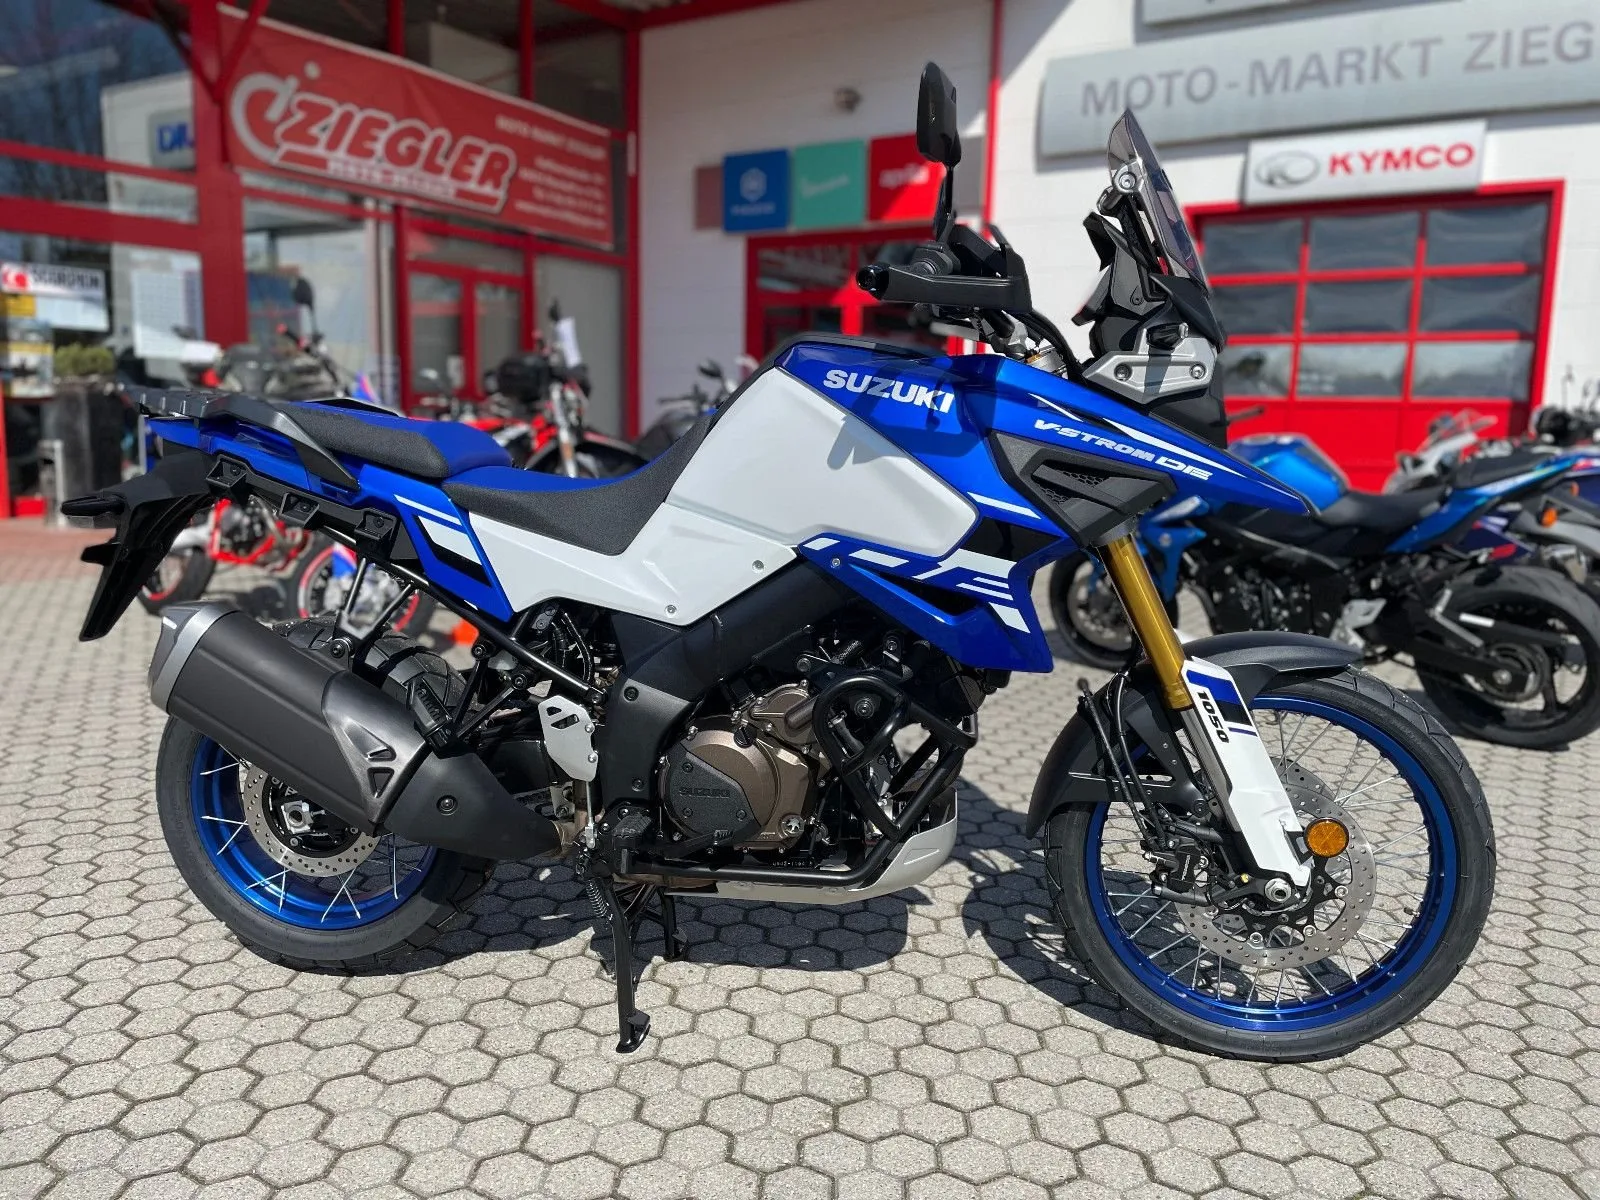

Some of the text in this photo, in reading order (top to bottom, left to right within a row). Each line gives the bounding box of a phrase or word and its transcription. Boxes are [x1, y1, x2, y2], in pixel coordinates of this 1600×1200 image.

[1463, 20, 1594, 74] ZIEG
[274, 91, 517, 198] ZIEGLER
[1328, 141, 1476, 176] KYMCO
[823, 368, 955, 414] SUZUKI
[1034, 419, 1214, 481] V-STROM DE
[1196, 690, 1230, 744] 1050
[679, 787, 731, 799] SUZUKI
